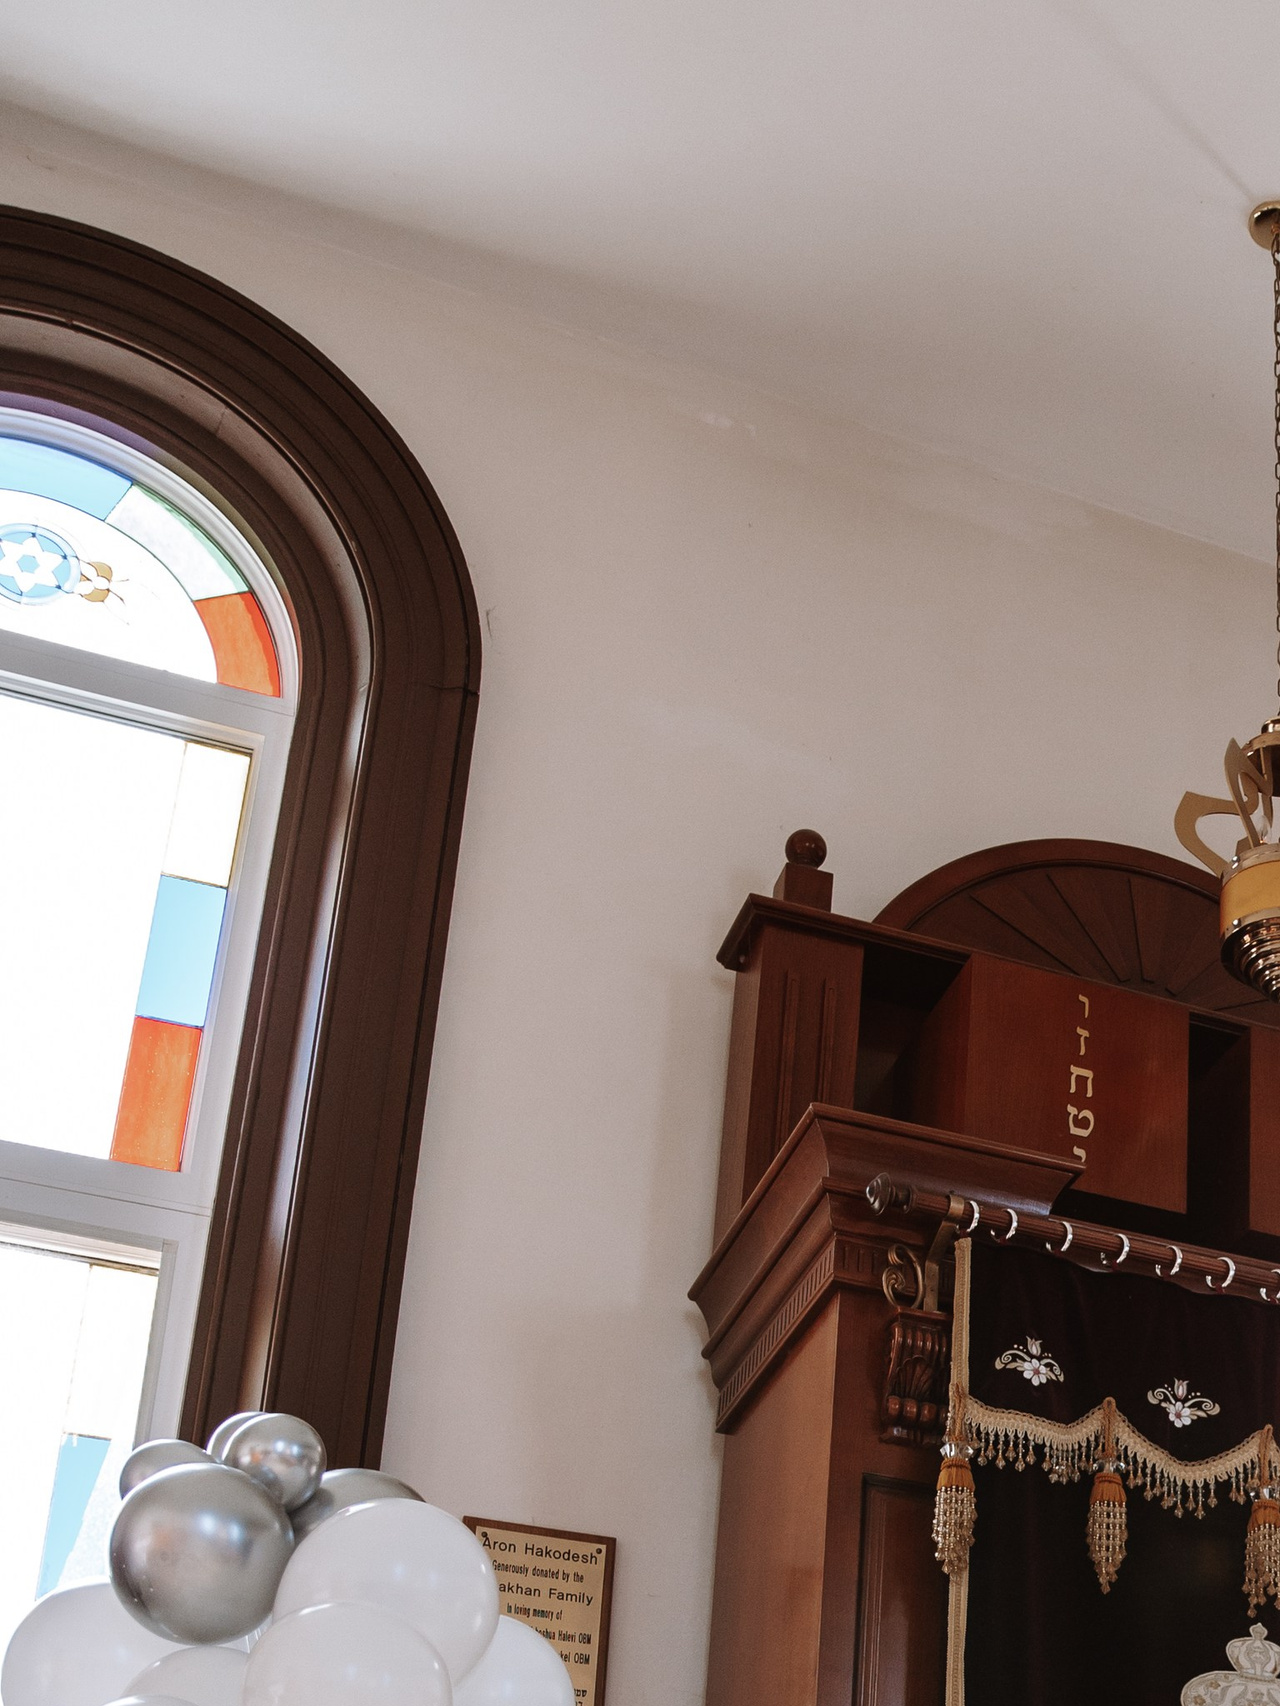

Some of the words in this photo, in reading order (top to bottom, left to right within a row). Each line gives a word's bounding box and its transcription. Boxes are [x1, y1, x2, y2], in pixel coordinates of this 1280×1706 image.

[482, 1537, 516, 1553] Aron
[524, 1543, 598, 1565] Hakodesh
[492, 1560, 529, 1577] Generously
[532, 1566, 560, 1580] donated
[562, 1570, 570, 1583] by
[573, 1572, 584, 1583] the
[499, 1582, 541, 1597] akhan
[549, 1588, 593, 1606] Family
[514, 1604, 531, 1618] loving
[533, 1608, 554, 1621] memory
[556, 1610, 563, 1620] of
[558, 1630, 577, 1643] Halevi
[573, 1653, 590, 1665] OBM
